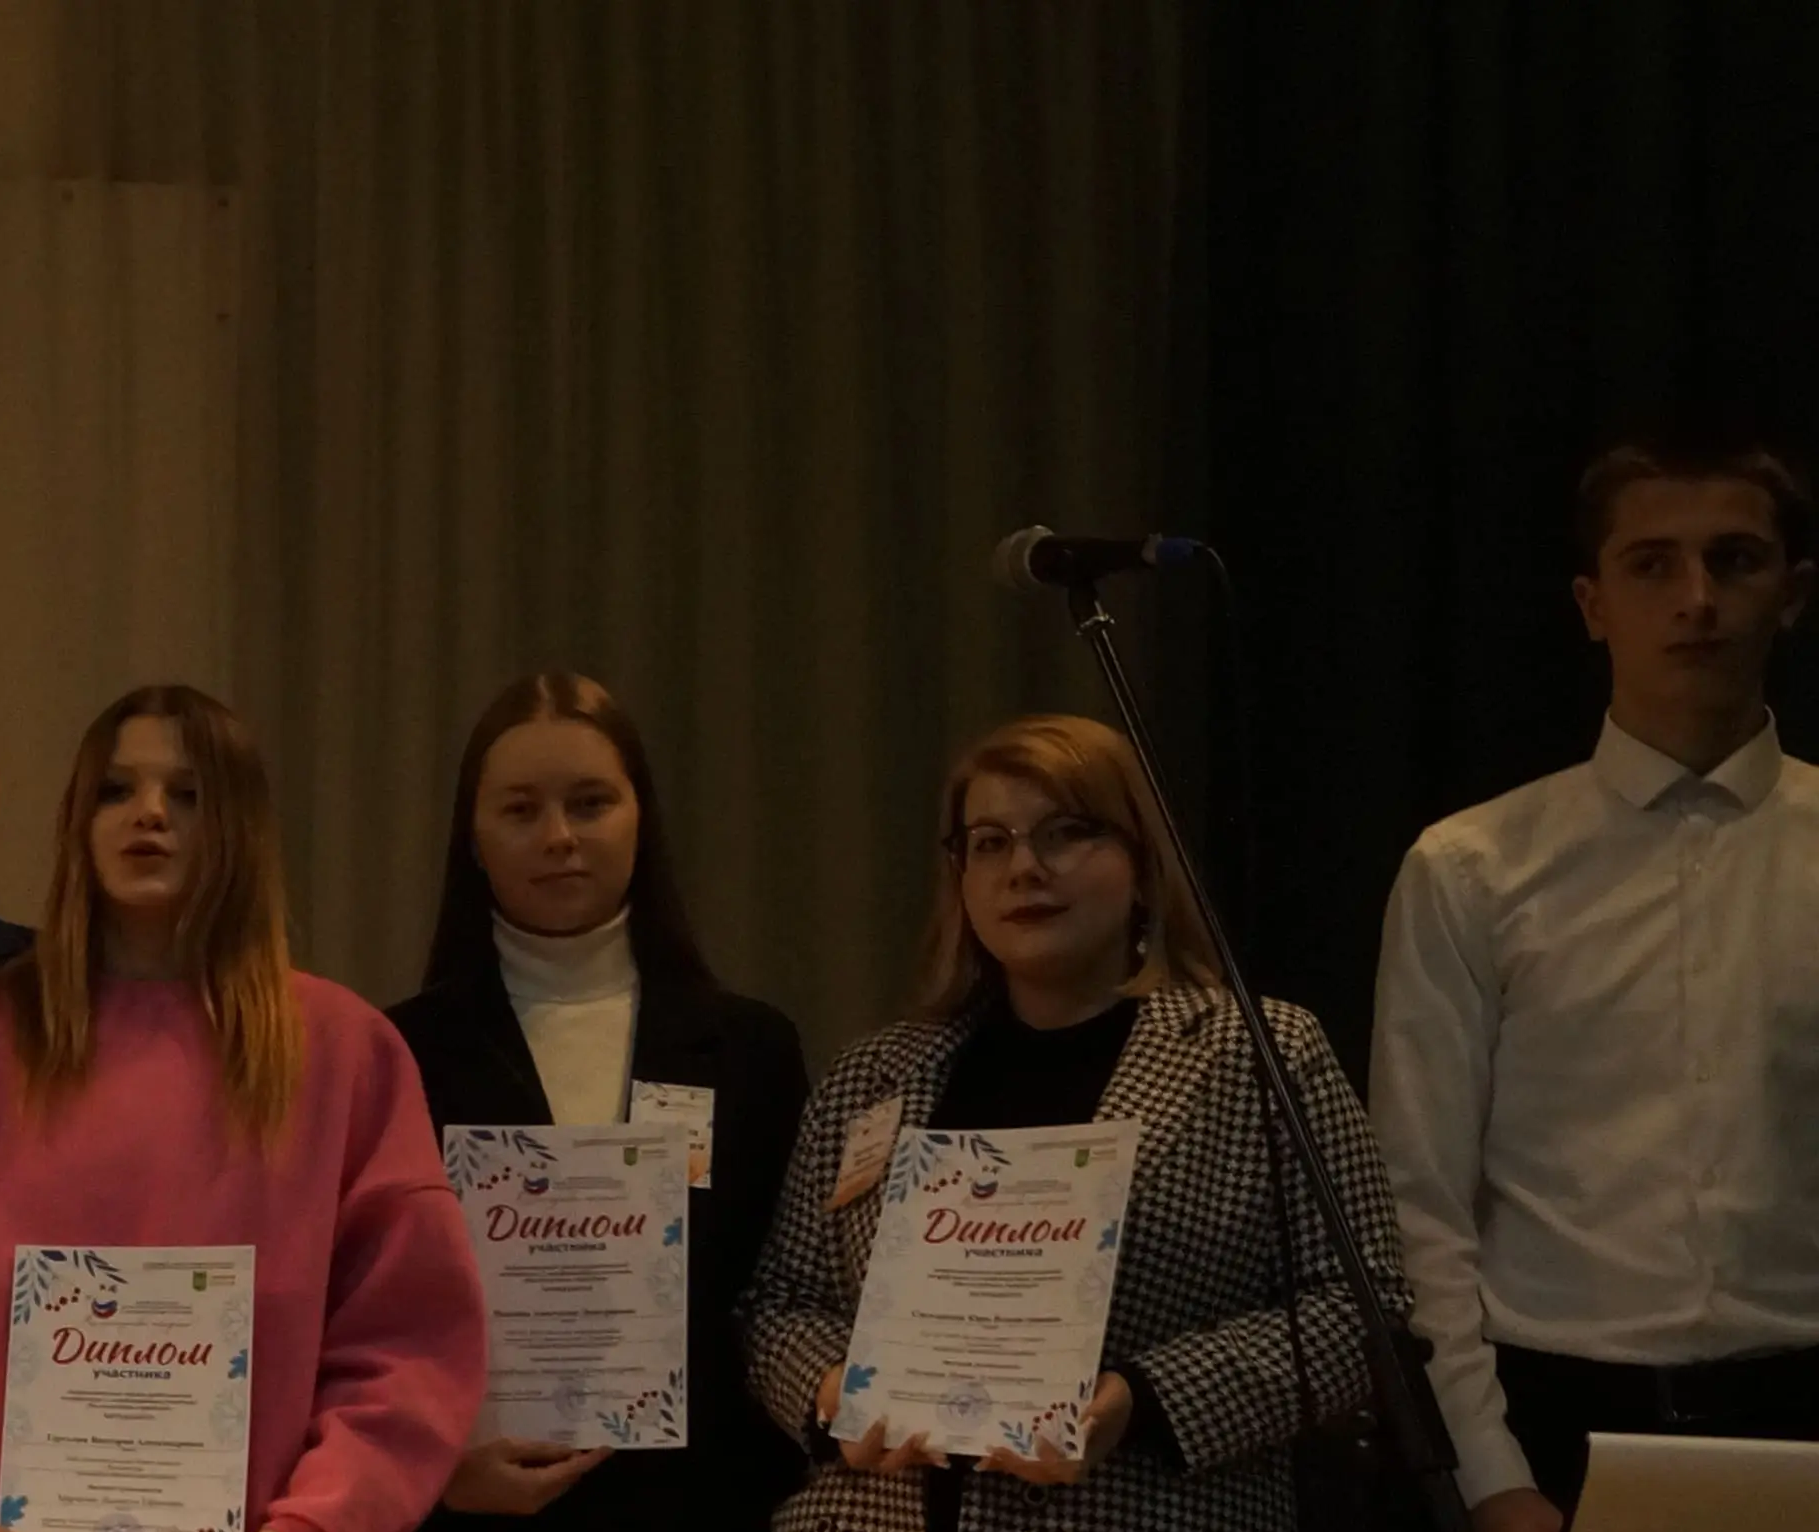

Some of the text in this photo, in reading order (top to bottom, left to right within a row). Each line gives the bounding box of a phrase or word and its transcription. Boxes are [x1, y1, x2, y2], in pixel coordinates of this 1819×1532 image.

[485, 1204, 648, 1242] Диплом
[923, 1208, 1087, 1244] Диплом
[51, 1327, 213, 1367] Диплом
[92, 1368, 172, 1381] участника
